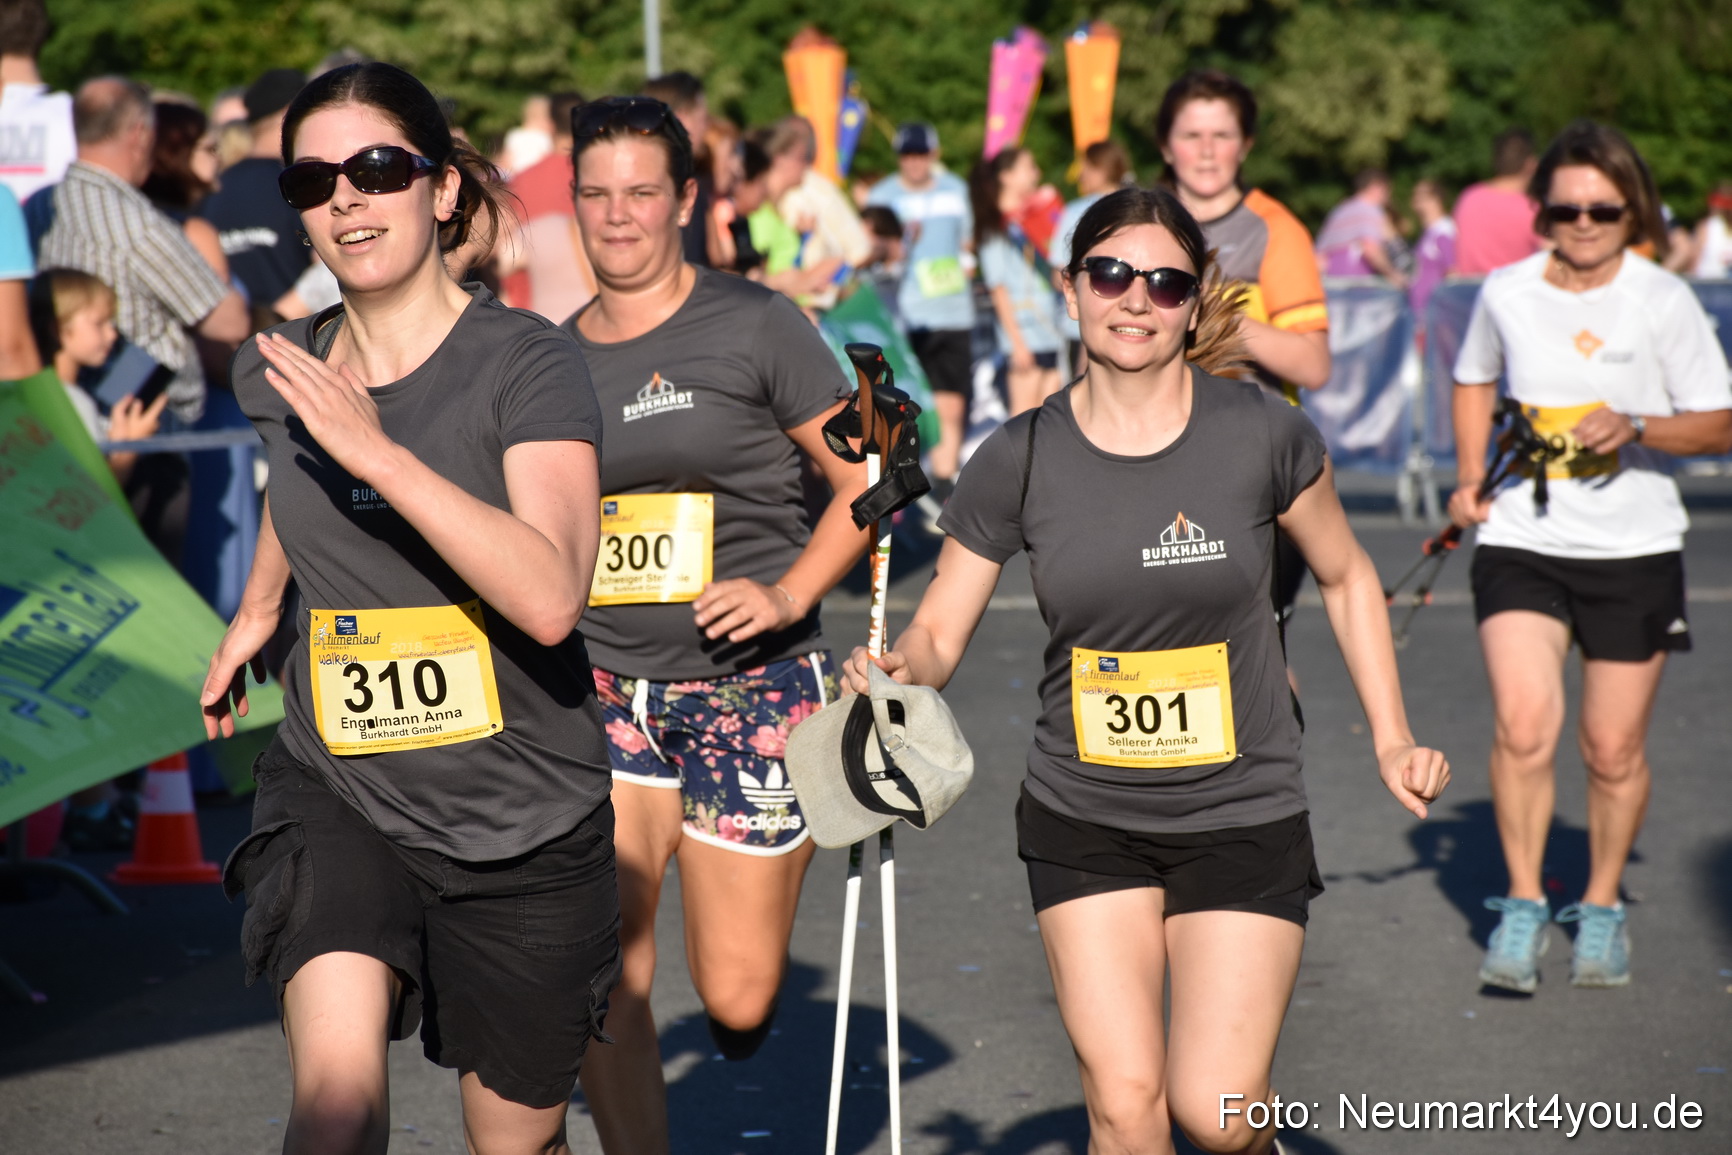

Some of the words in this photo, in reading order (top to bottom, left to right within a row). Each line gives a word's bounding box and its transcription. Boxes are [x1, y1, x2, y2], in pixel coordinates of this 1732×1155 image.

[623, 391, 693, 417] BURKHARDT
[606, 534, 675, 572] 300
[1142, 540, 1225, 560] BURKHARDT
[327, 632, 381, 645] firmenlauf
[390, 641, 423, 654] 2018
[1090, 669, 1140, 681] firmenlauf
[342, 659, 448, 713] 310
[424, 709, 463, 723] Anna
[1105, 692, 1188, 734] 301
[361, 728, 409, 740] Burkhardt
[411, 724, 443, 735] GmbH
[1108, 736, 1151, 747] Sellerer
[1155, 736, 1198, 747] Annika
[1119, 748, 1158, 757] Burkhardt
[1161, 748, 1187, 756] GmbH
[732, 813, 801, 831] adidas
